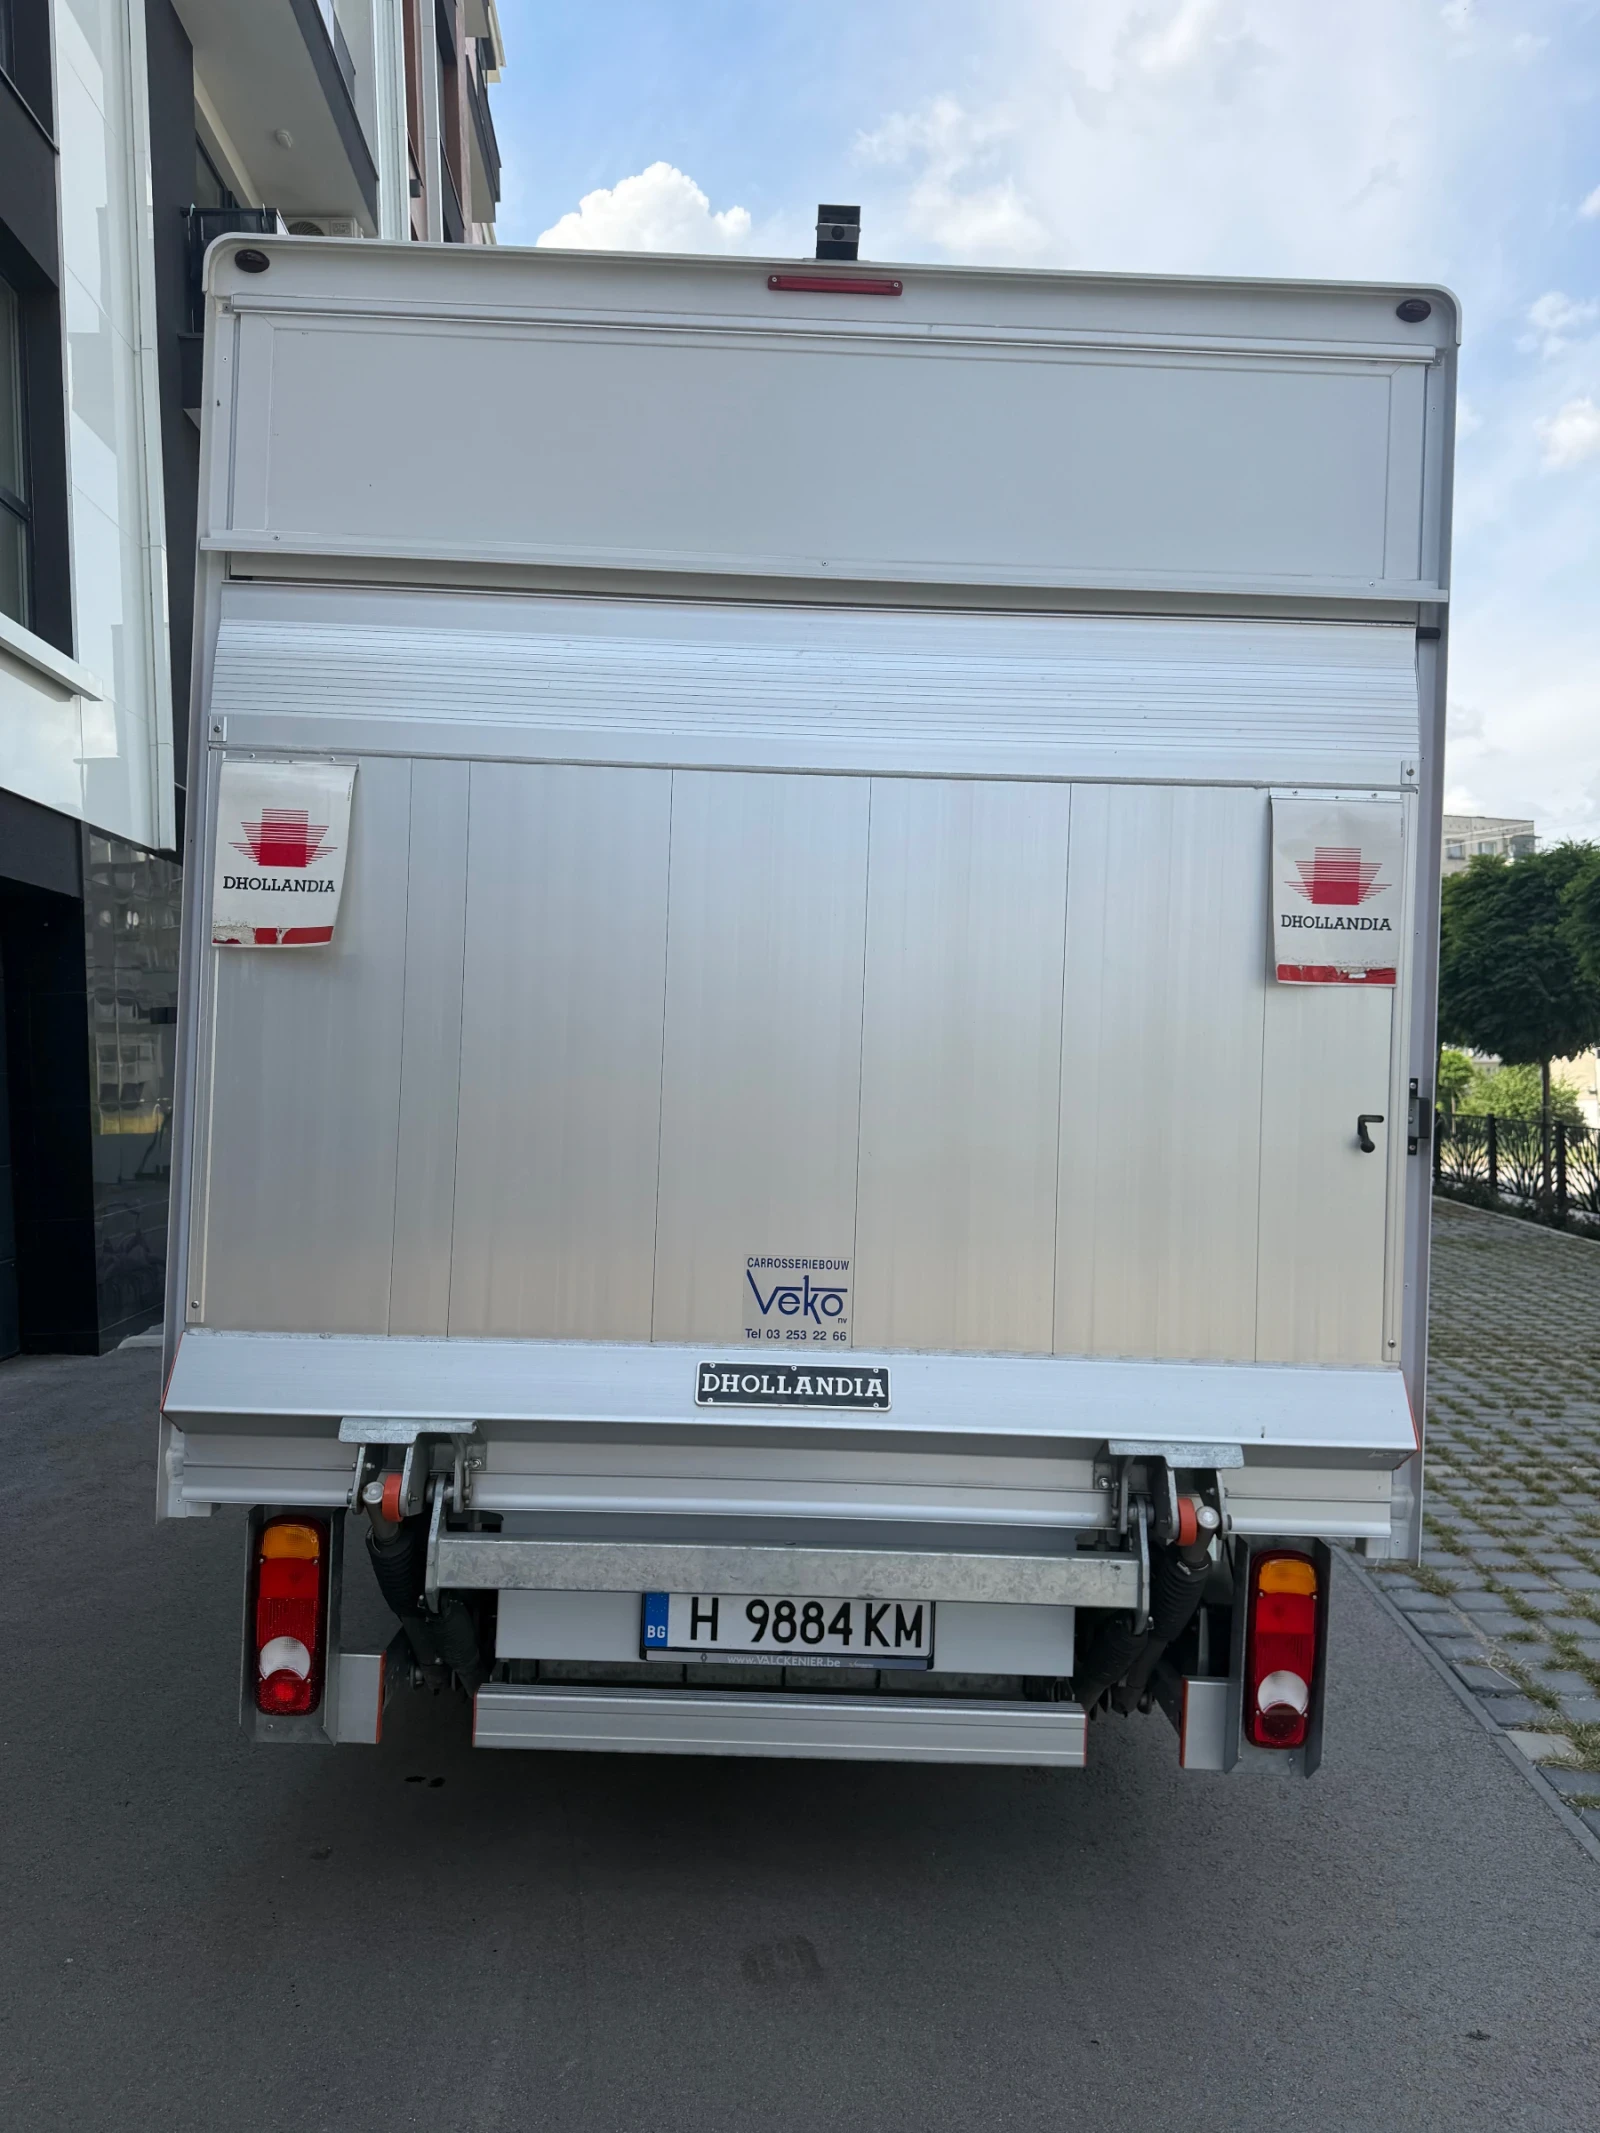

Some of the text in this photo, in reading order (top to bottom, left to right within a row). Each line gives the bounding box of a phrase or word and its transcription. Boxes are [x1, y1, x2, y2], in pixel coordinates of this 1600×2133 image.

[223, 876, 335, 893] DHOLLANDIA
[1281, 915, 1392, 931] DHOLLANDIA
[747, 1257, 849, 1270] CARROSSERIEBOUW
[745, 1328, 846, 1341] Tel 03 253 22 66
[702, 1373, 885, 1397] DHOLLANDIA
[690, 1596, 923, 1648] H 9884 KM
[647, 1625, 666, 1638] BG
[727, 1655, 841, 1667] www.VALCKENIER.be
